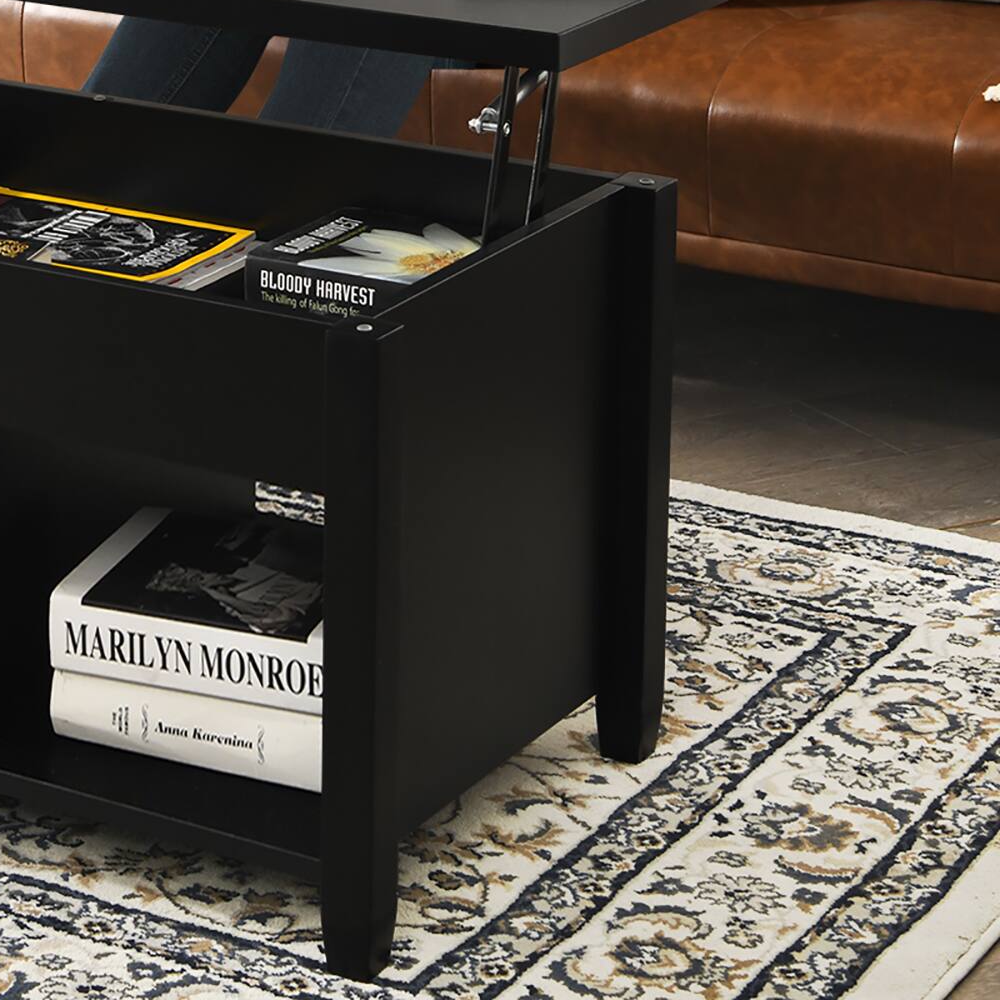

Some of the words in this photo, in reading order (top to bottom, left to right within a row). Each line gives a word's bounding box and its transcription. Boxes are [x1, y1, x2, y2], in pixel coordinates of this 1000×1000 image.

[260, 270, 312, 295] BLOODY
[316, 279, 376, 306] HARVEST
[261, 291, 275, 303] The
[275, 293, 297, 309] killing
[299, 298, 308, 308] of
[328, 302, 348, 318] Gong
[64, 621, 192, 676] MARILYN
[200, 644, 323, 698] MONROE
[154, 721, 188, 738] Anna
[192, 727, 253, 750] Karenina
